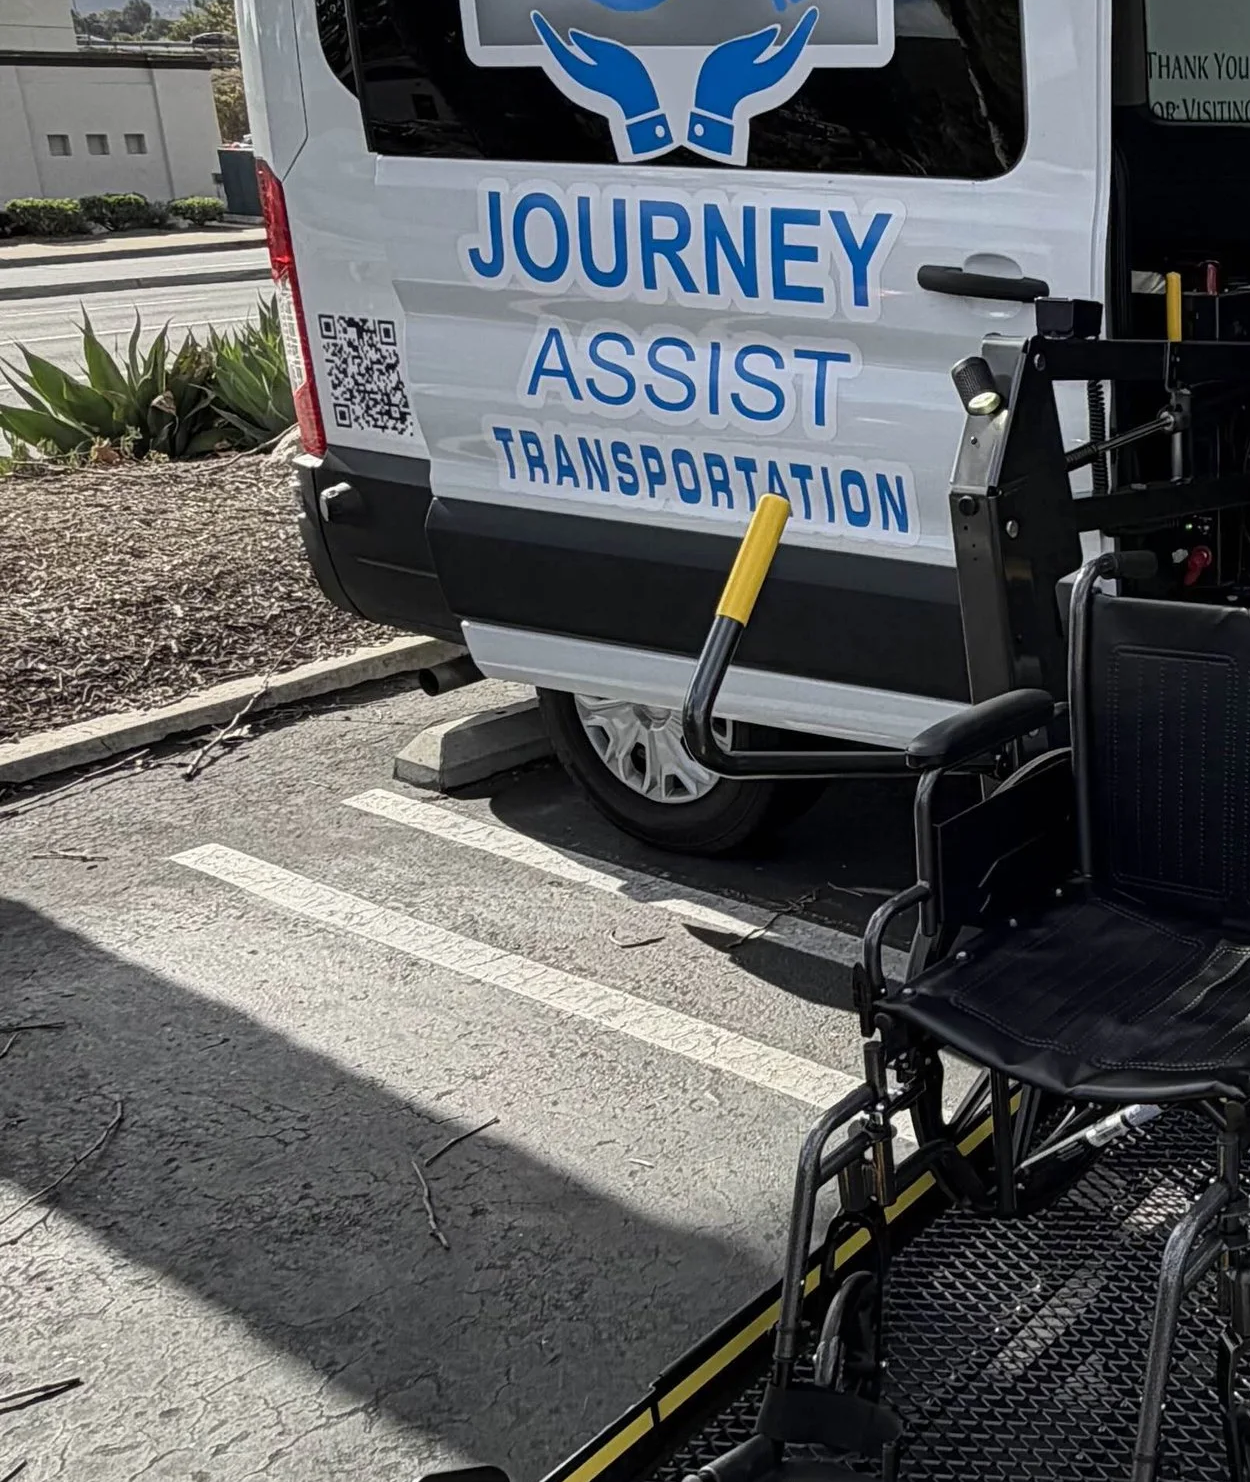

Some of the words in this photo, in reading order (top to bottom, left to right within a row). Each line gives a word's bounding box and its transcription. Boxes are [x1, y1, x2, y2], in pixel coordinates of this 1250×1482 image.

[1147, 51, 1209, 79] THANK
[1213, 52, 1249, 80] YOU
[1151, 101, 1177, 120] OR
[468, 191, 892, 307] JOURNEY
[527, 327, 851, 427] ASSIST
[492, 426, 909, 533] TRANSPORTATION
